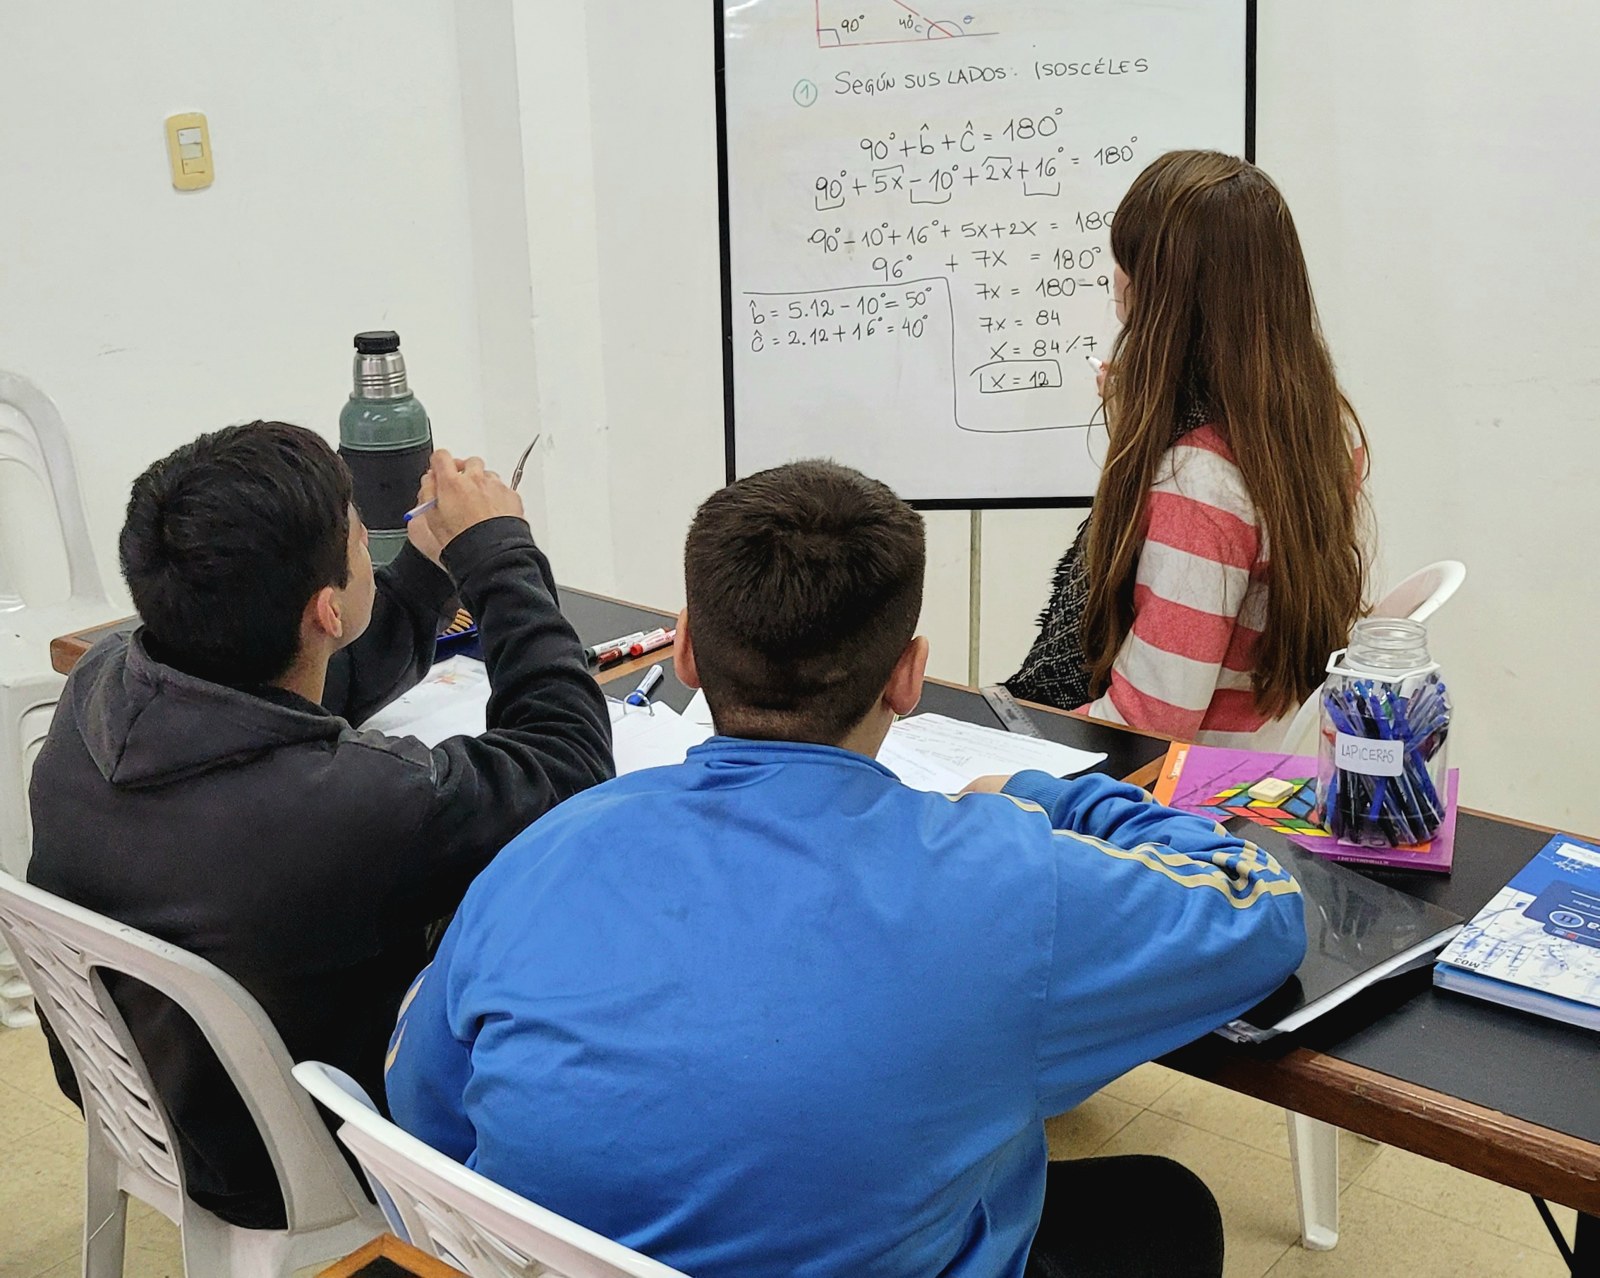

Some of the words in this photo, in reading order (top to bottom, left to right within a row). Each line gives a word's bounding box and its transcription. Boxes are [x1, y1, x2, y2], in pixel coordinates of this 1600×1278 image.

[842, 14, 865, 33] 90°
[904, 72, 940, 89] SUS
[1035, 57, 1148, 80] ISOSCÉLES
[860, 132, 896, 161] 90°
[1003, 107, 1063, 141] 180°
[815, 169, 847, 200] 90°
[1094, 136, 1138, 165] 180°
[872, 254, 912, 282] 96°
[1053, 247, 1101, 270] 180°
[905, 286, 932, 308] 50°
[902, 314, 928, 338] 40°
[1036, 310, 1061, 326] 84
[1029, 371, 1048, 388] 12
[1341, 743, 1394, 764] LAPICERAS
[1453, 957, 1481, 969] M03
